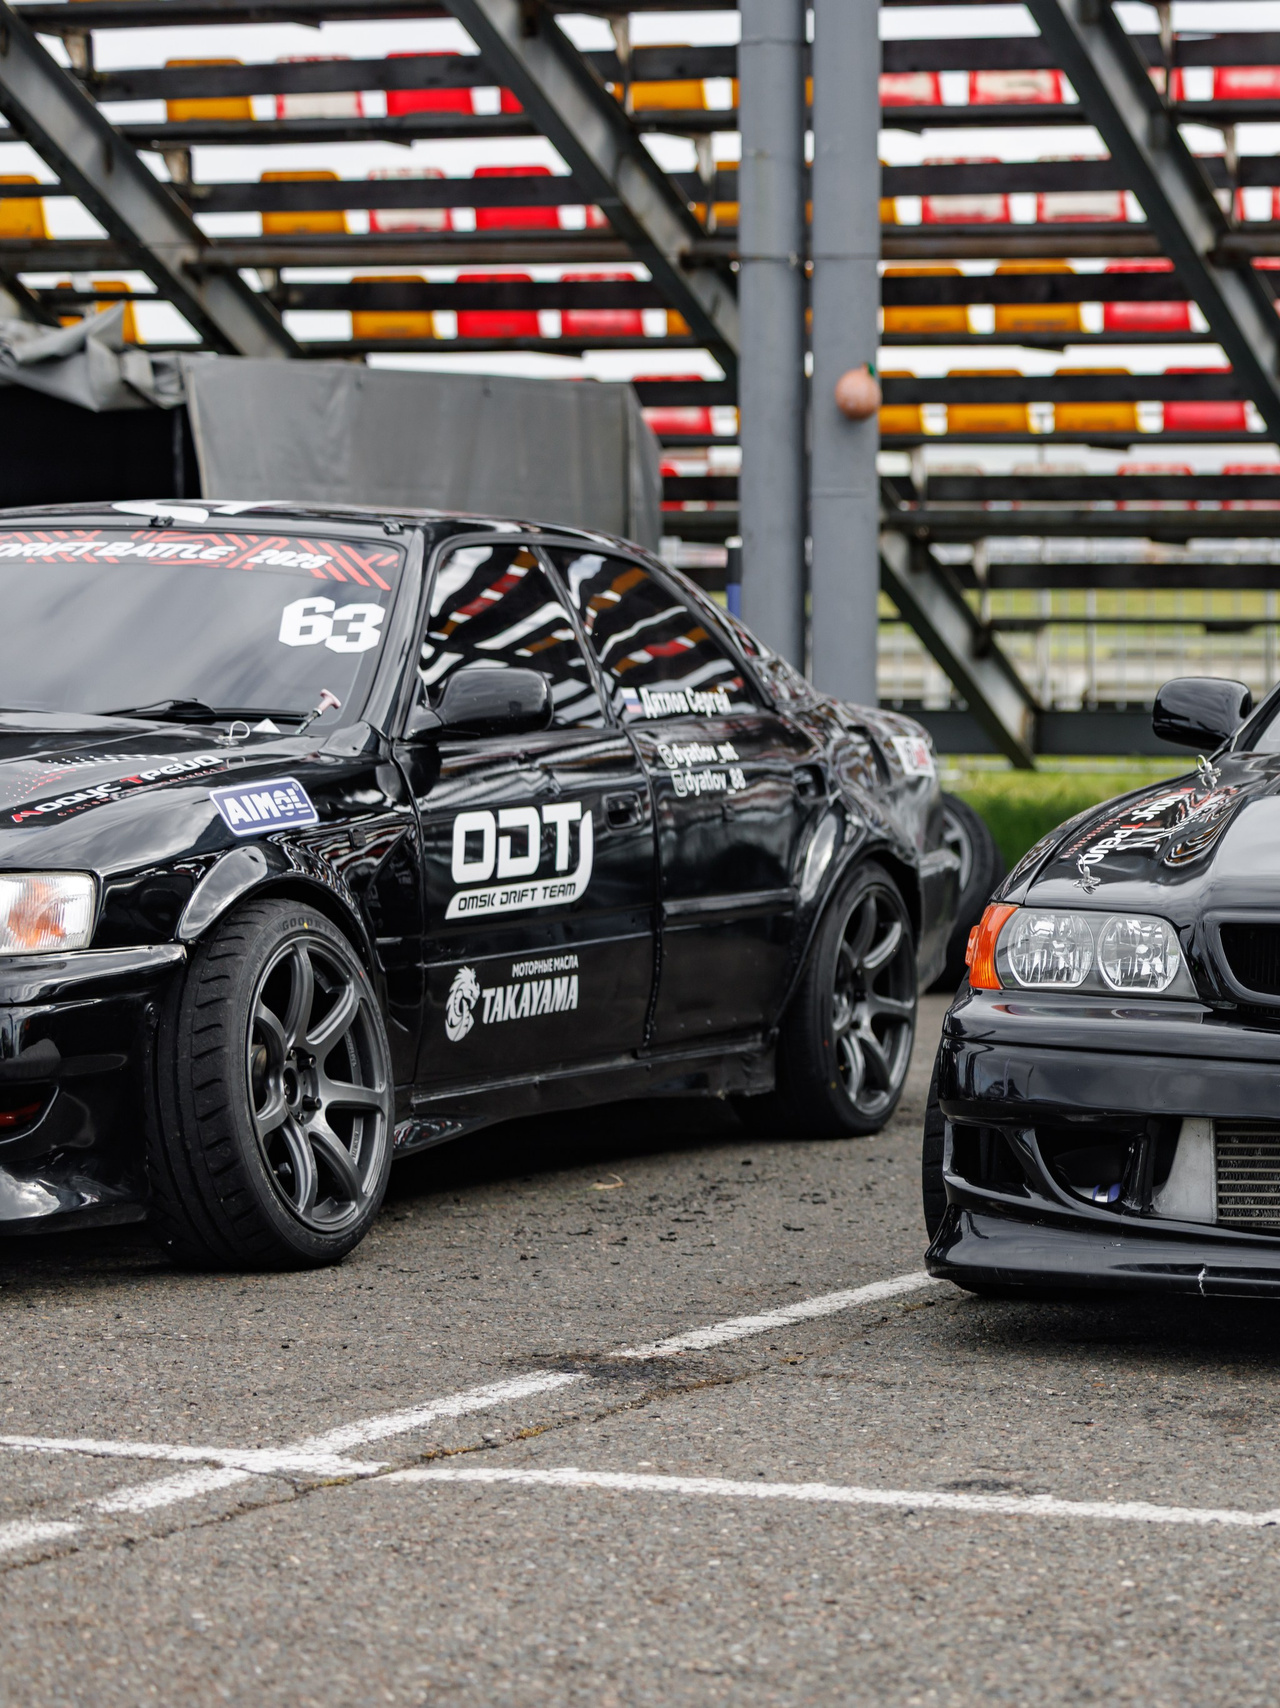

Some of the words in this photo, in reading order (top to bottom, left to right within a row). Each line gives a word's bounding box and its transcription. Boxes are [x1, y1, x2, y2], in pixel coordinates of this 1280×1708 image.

[94, 541, 237, 561] BATTLE
[247, 548, 334, 570] 2025
[278, 596, 386, 653] 63
[639, 687, 690, 719] Дятлов
[685, 686, 732, 718] Сергей
[223, 788, 311, 825] AIMOL
[452, 801, 582, 884] ODT
[458, 892, 496, 912] OMSK
[500, 887, 538, 906] DRIFT
[542, 882, 576, 900] TEAM
[512, 957, 553, 978] МОТОРНЫЕ
[553, 954, 579, 972] МАСЛА
[482, 974, 579, 1024] TAKAYAMA
